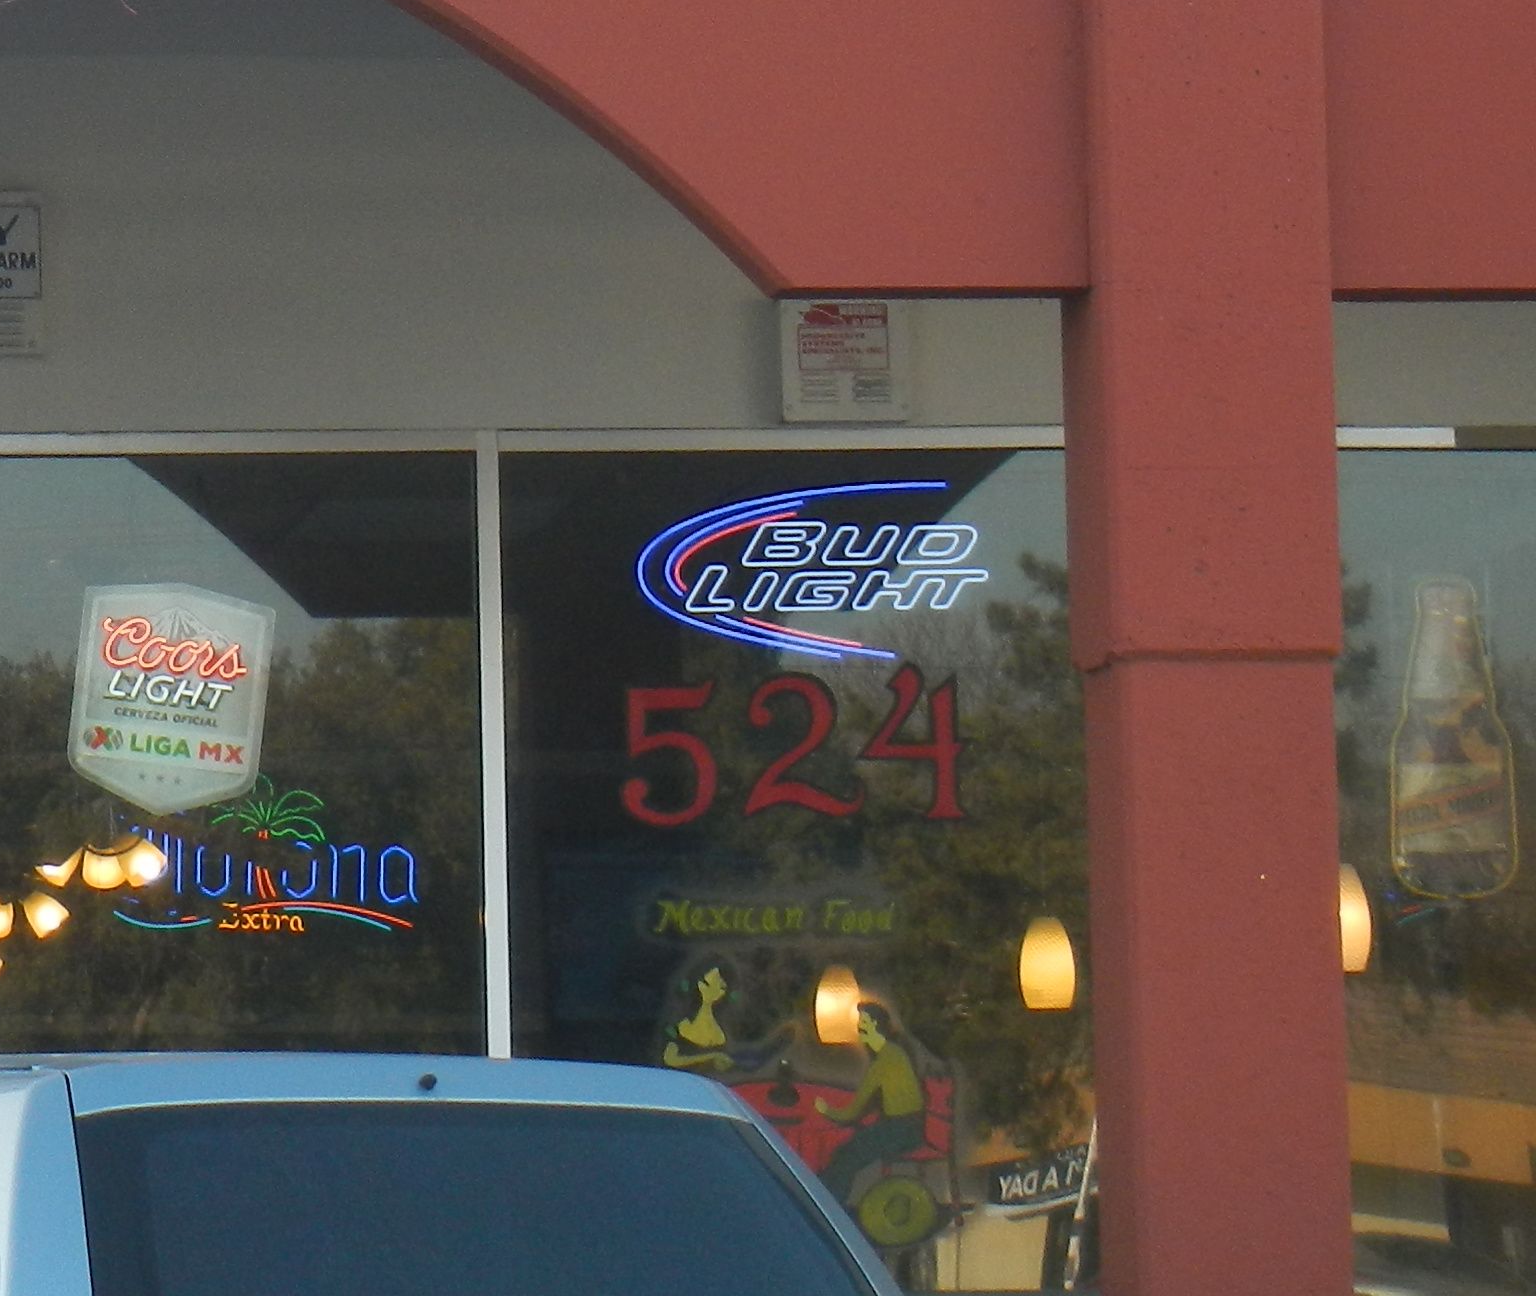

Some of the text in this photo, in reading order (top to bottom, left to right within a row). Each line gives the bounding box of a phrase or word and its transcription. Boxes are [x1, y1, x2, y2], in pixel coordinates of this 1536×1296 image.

[741, 521, 978, 568] BUD
[685, 564, 989, 613] LIGHT
[102, 616, 249, 680] Coors
[108, 669, 233, 711] LIGHT
[113, 706, 218, 729] CERVEZA OFICIAL
[130, 733, 244, 765] LIGA MX
[619, 661, 969, 828] 524
[218, 902, 305, 933] Extra
[653, 899, 896, 935] Mexican Food
